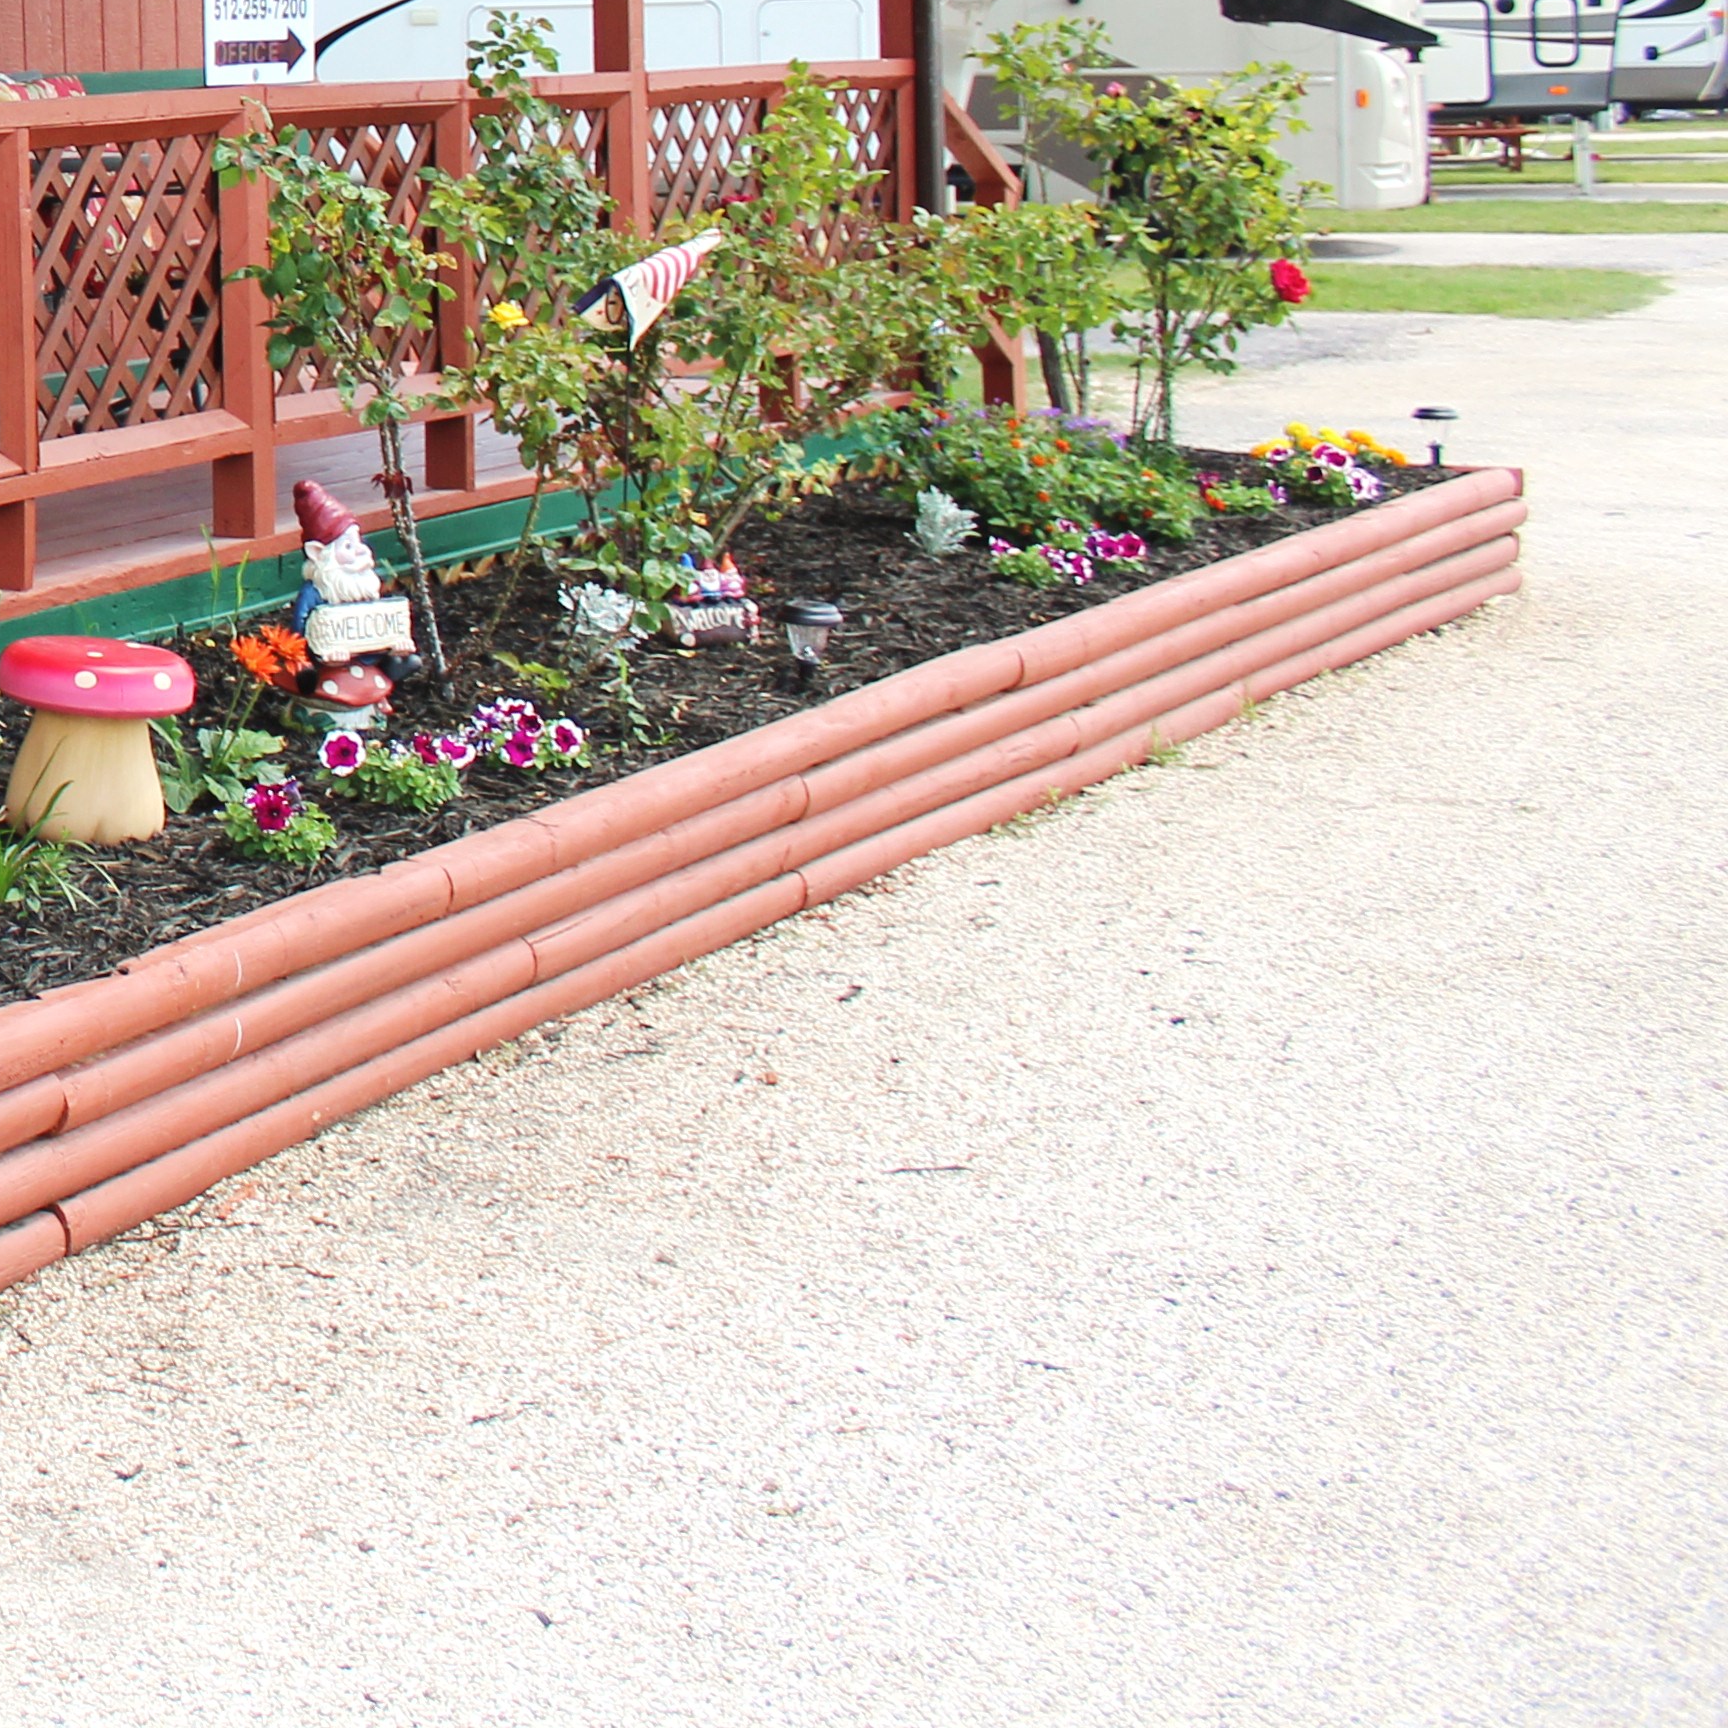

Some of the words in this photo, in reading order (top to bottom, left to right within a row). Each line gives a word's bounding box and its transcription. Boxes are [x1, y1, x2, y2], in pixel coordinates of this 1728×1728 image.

[216, 40, 280, 67] OFFICE
[331, 611, 405, 641] WELCOME
[678, 605, 746, 632] WELCOME
